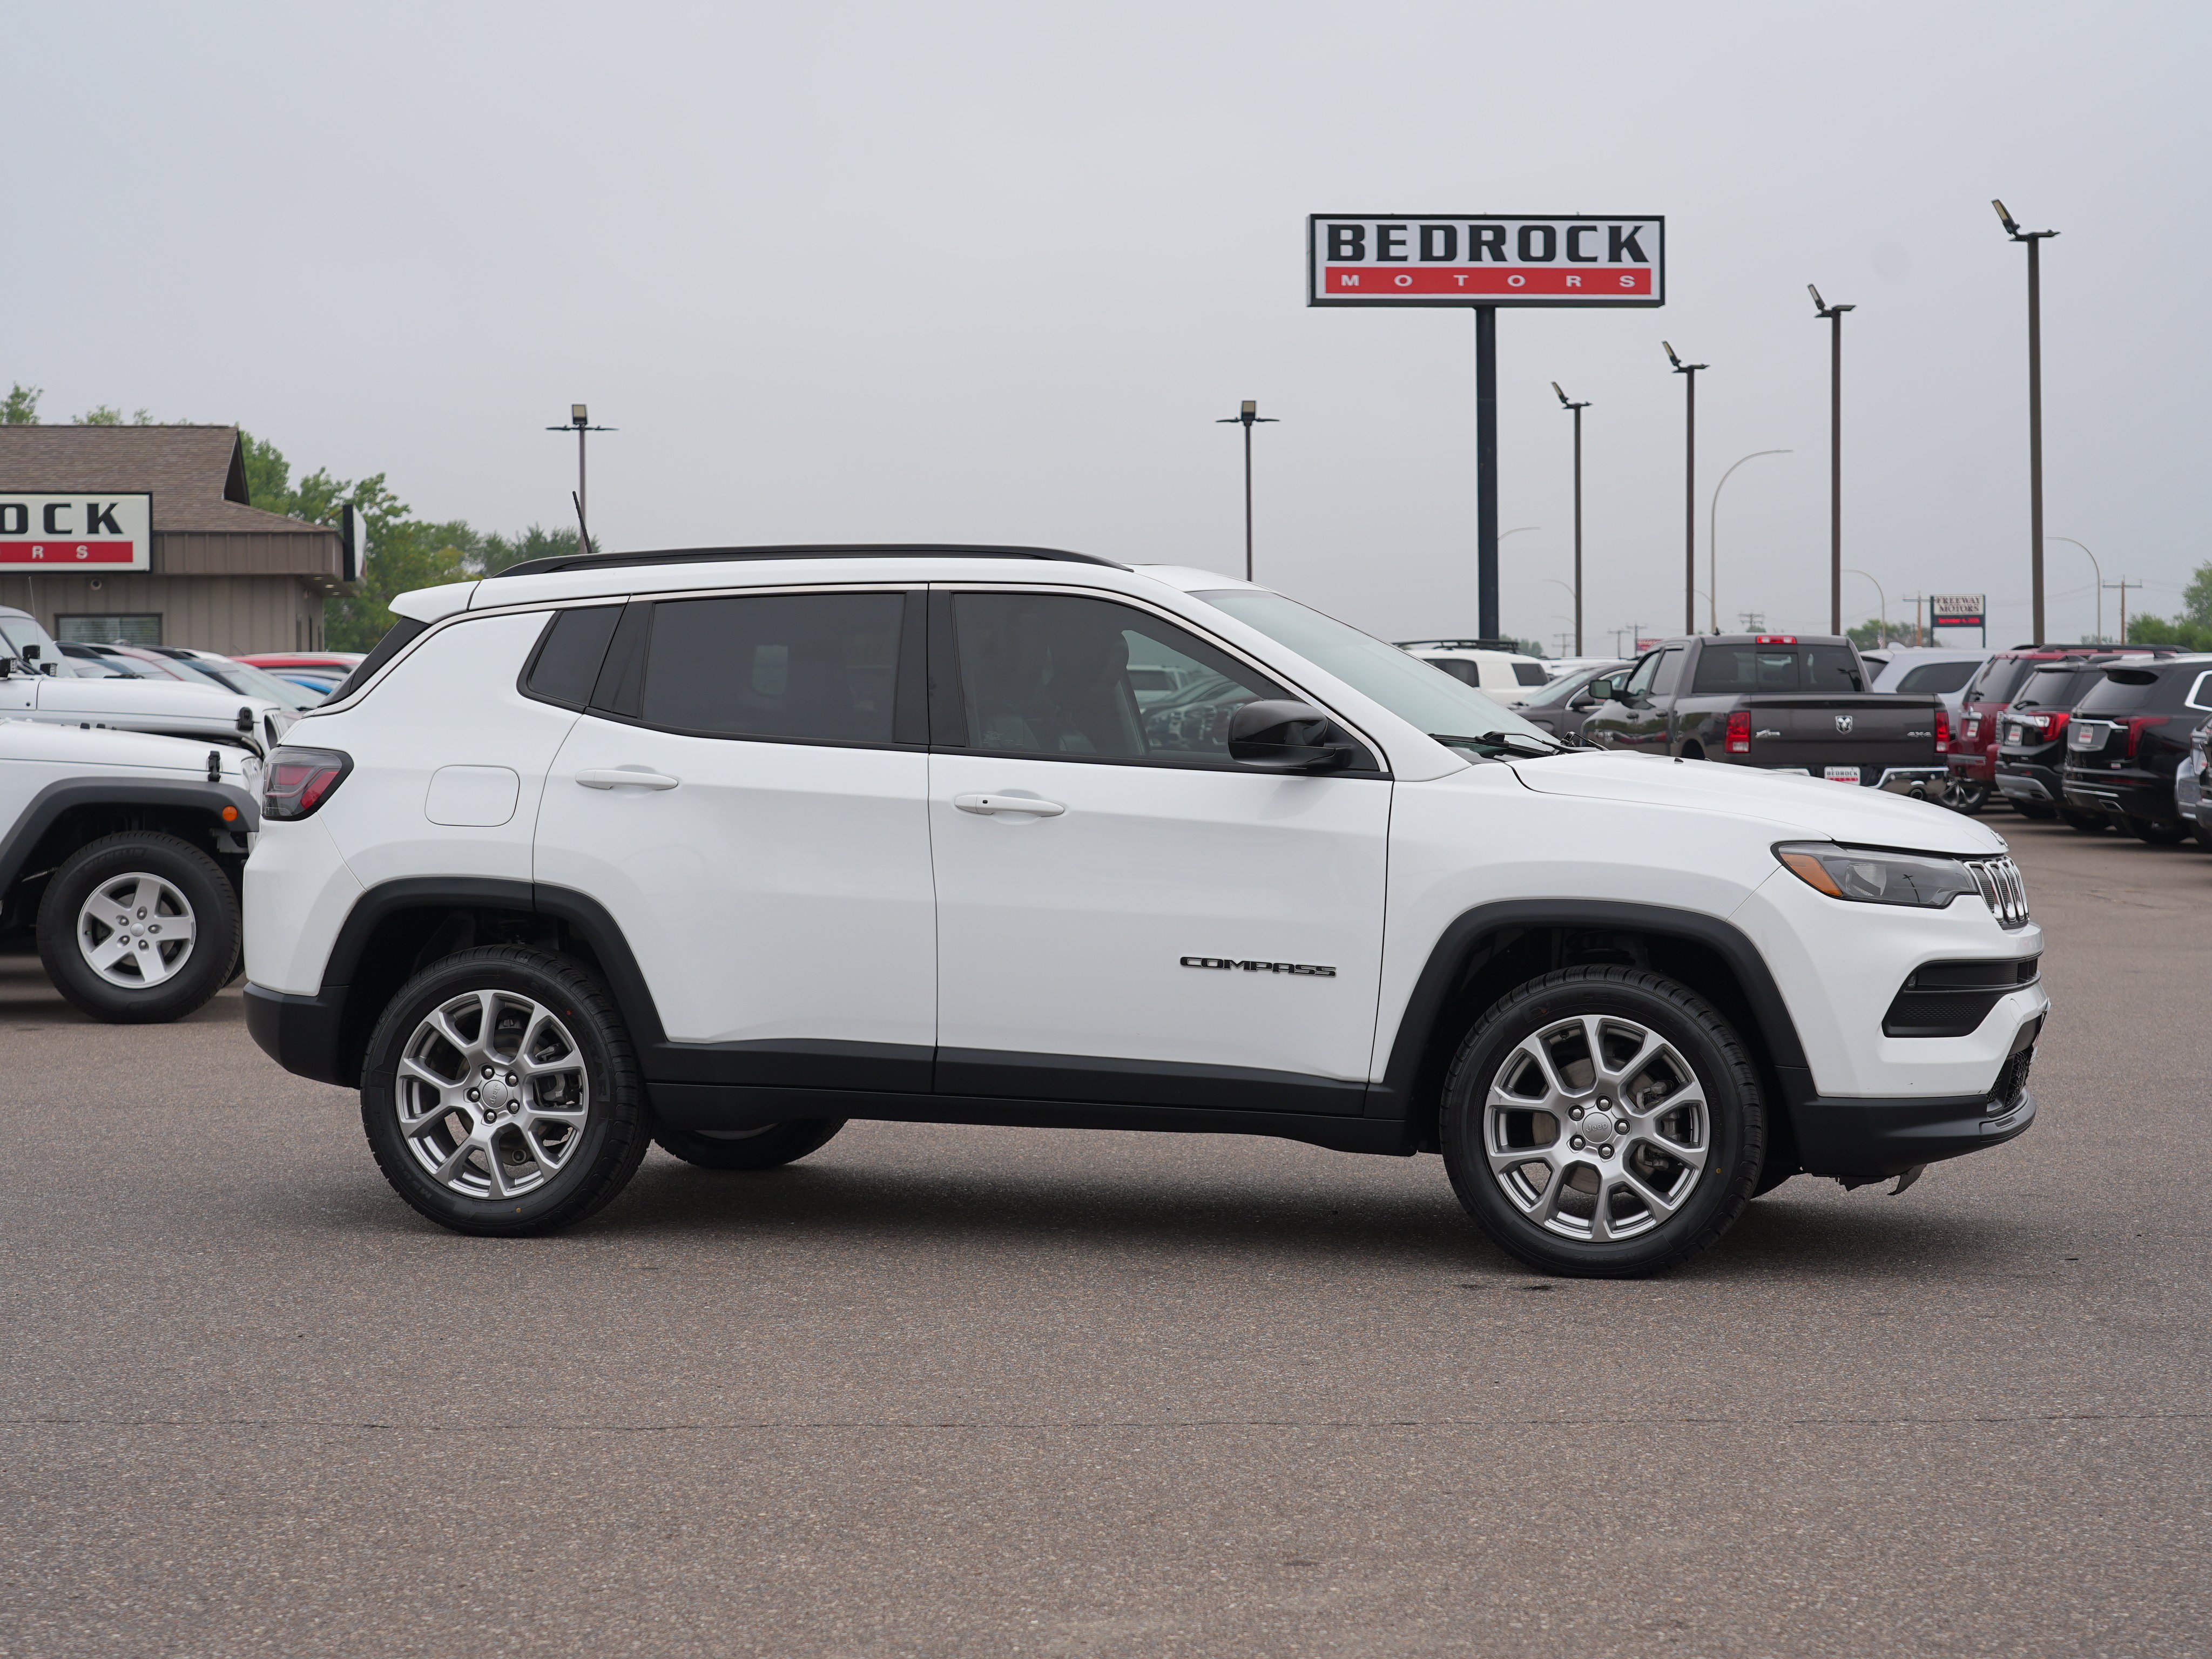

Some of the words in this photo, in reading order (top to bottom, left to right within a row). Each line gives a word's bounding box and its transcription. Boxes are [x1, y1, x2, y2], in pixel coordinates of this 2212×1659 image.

[1327, 224, 1650, 262] BEDROCK
[1340, 274, 1635, 287] MOTORS
[0, 502, 125, 535] OCK
[1180, 956, 1337, 977] COMPASS
[490, 1083, 500, 1104] Jeep
[1586, 1123, 1608, 1132] Jeep
